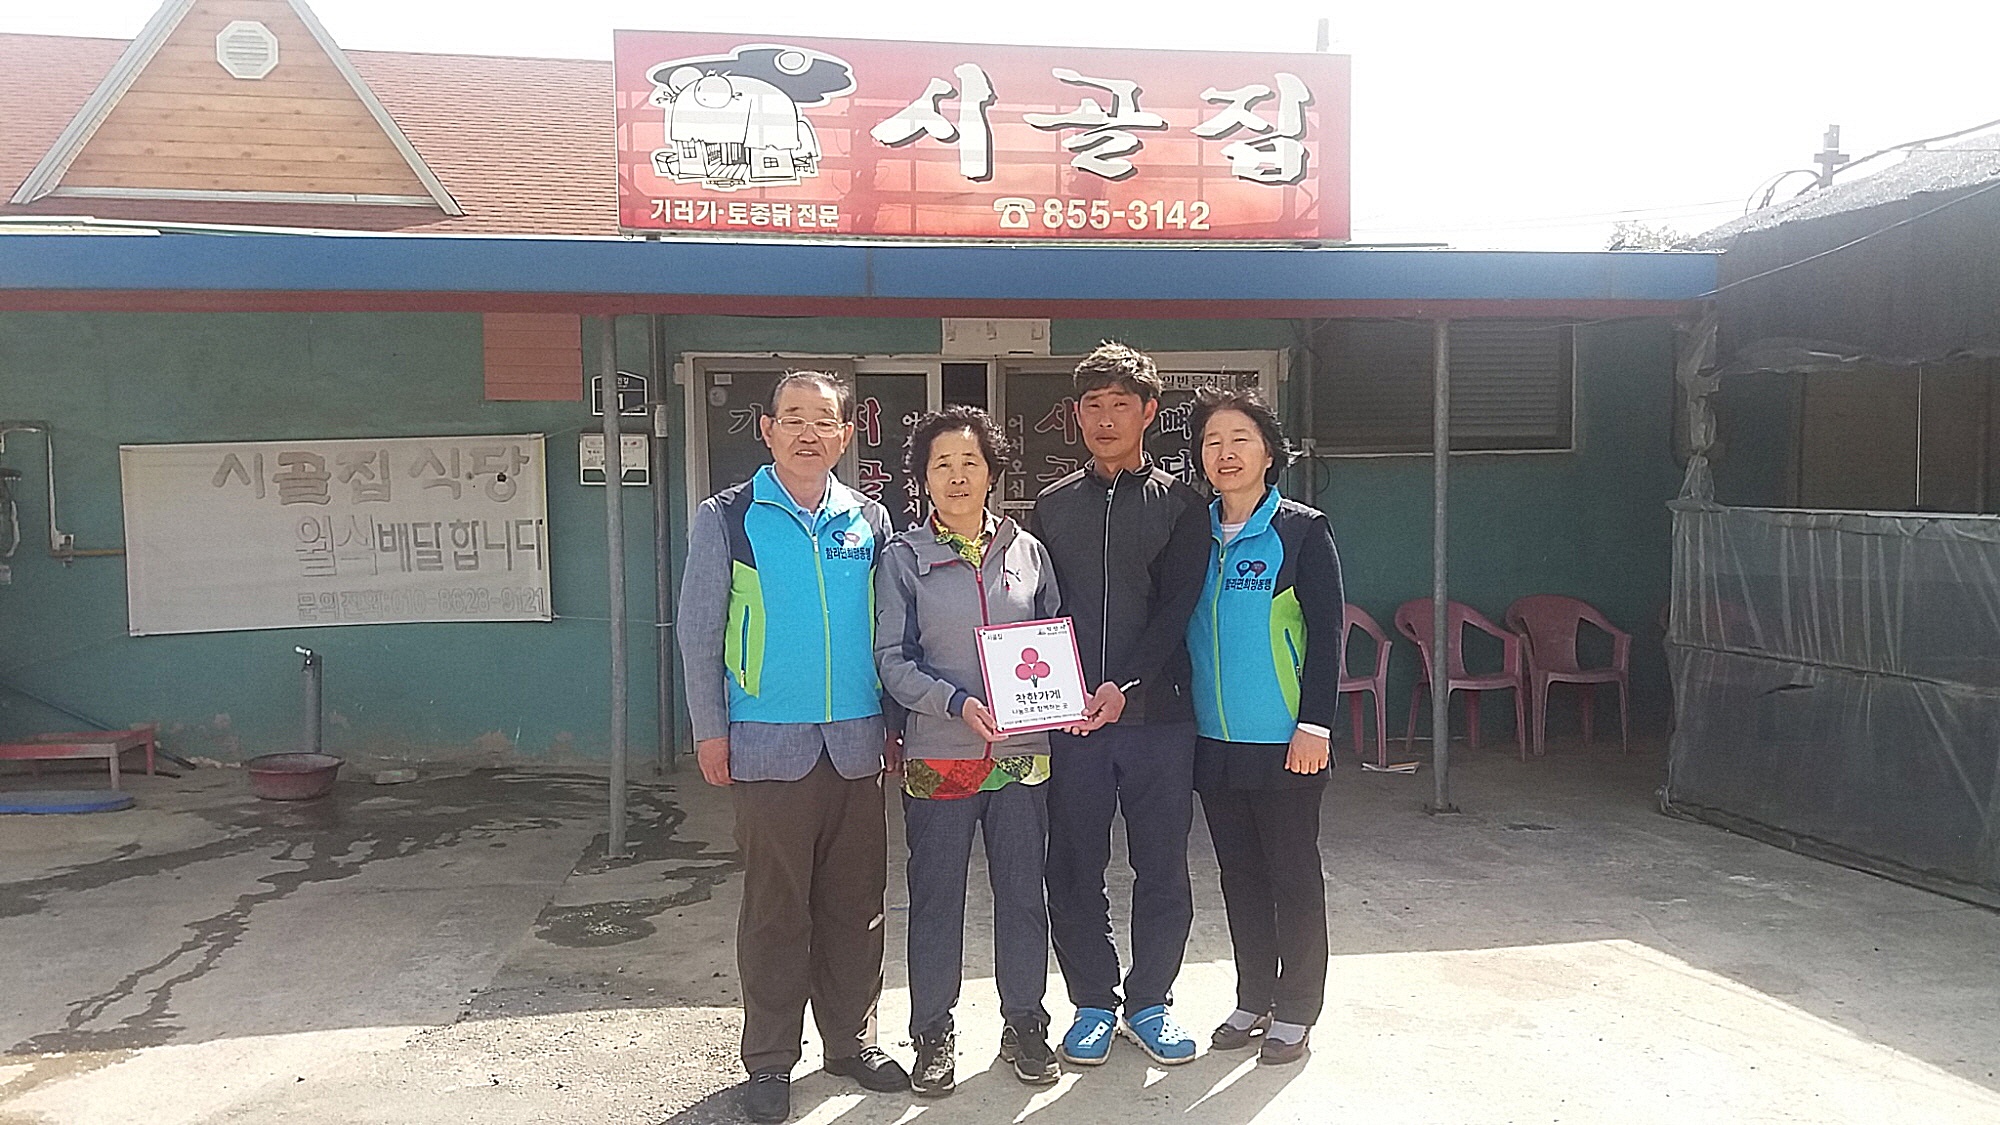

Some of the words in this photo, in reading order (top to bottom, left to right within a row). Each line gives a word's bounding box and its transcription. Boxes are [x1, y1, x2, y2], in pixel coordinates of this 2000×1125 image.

[870, 63, 1314, 187] 시골집
[796, 203, 840, 228] 전문
[1043, 198, 1211, 232] 855-3142
[212, 449, 392, 507] 시골집
[408, 445, 531, 503] 식당
[1015, 689, 1062, 705] 착한가게
